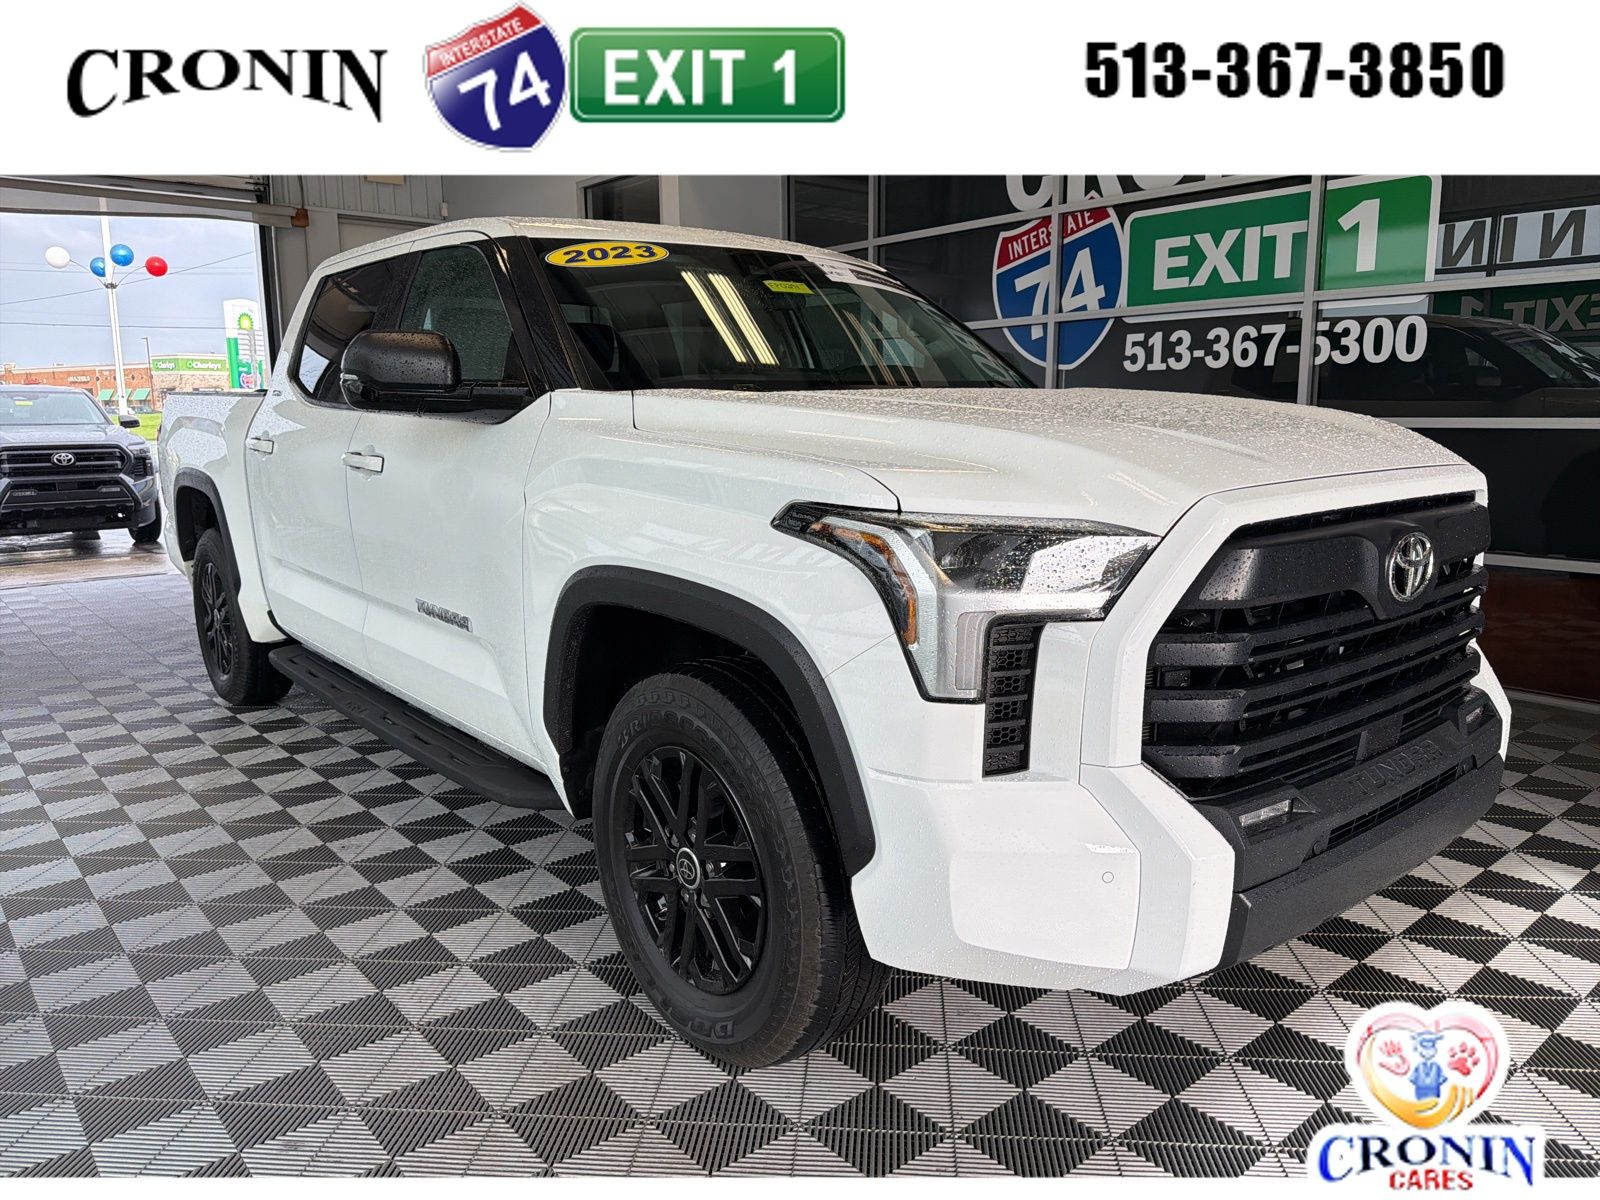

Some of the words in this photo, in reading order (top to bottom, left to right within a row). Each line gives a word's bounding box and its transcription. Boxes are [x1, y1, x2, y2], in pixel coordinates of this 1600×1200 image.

[563, 245, 657, 264] 2023
[1008, 210, 1095, 260] INTERATE
[1153, 220, 1308, 291] EXIT
[1337, 198, 1382, 272] 1
[1014, 246, 1106, 340] 74
[1122, 315, 1428, 373] 513-367-5300
